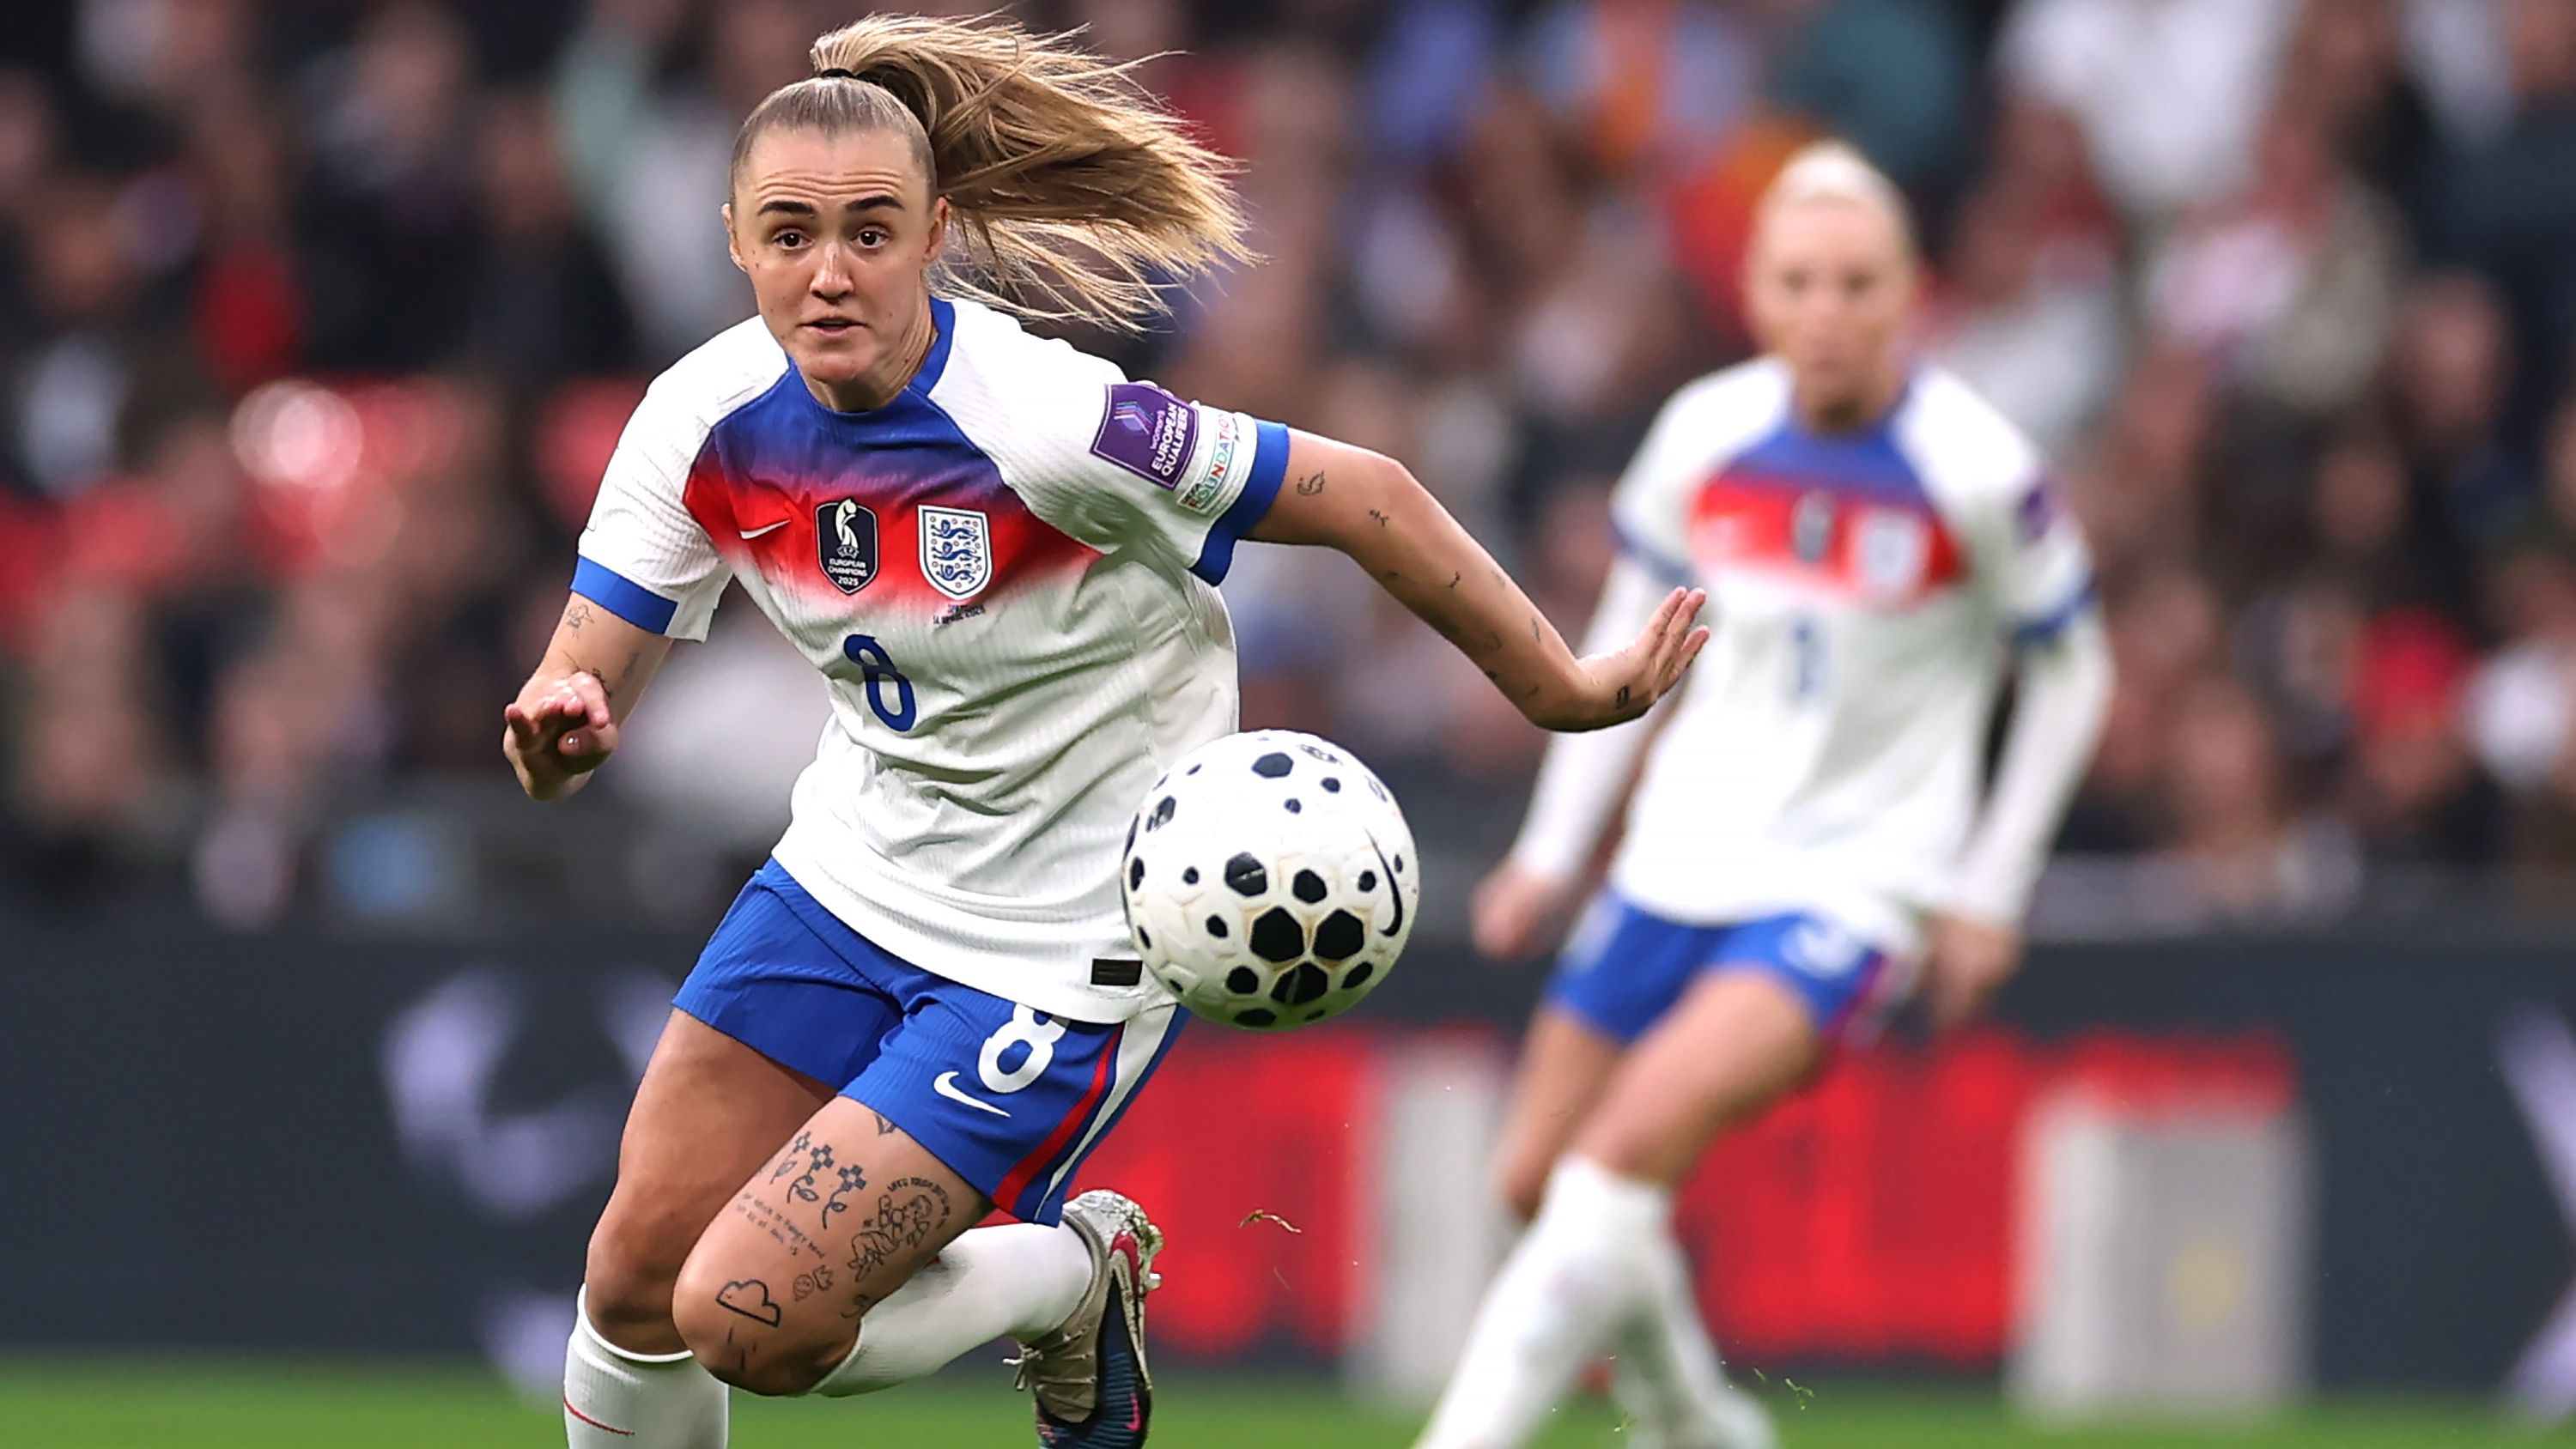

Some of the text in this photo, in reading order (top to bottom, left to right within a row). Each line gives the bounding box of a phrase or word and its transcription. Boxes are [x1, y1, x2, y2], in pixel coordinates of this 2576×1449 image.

[1151, 402, 1177, 470] EUROPEAN
[1161, 406, 1188, 476] QUALIFIERS
[827, 566, 867, 578] CHAMPIONS
[829, 558, 866, 569] EUROPEAN
[838, 576, 859, 586] 2025
[843, 634, 917, 732] 8
[978, 1003, 1066, 1094] 8
